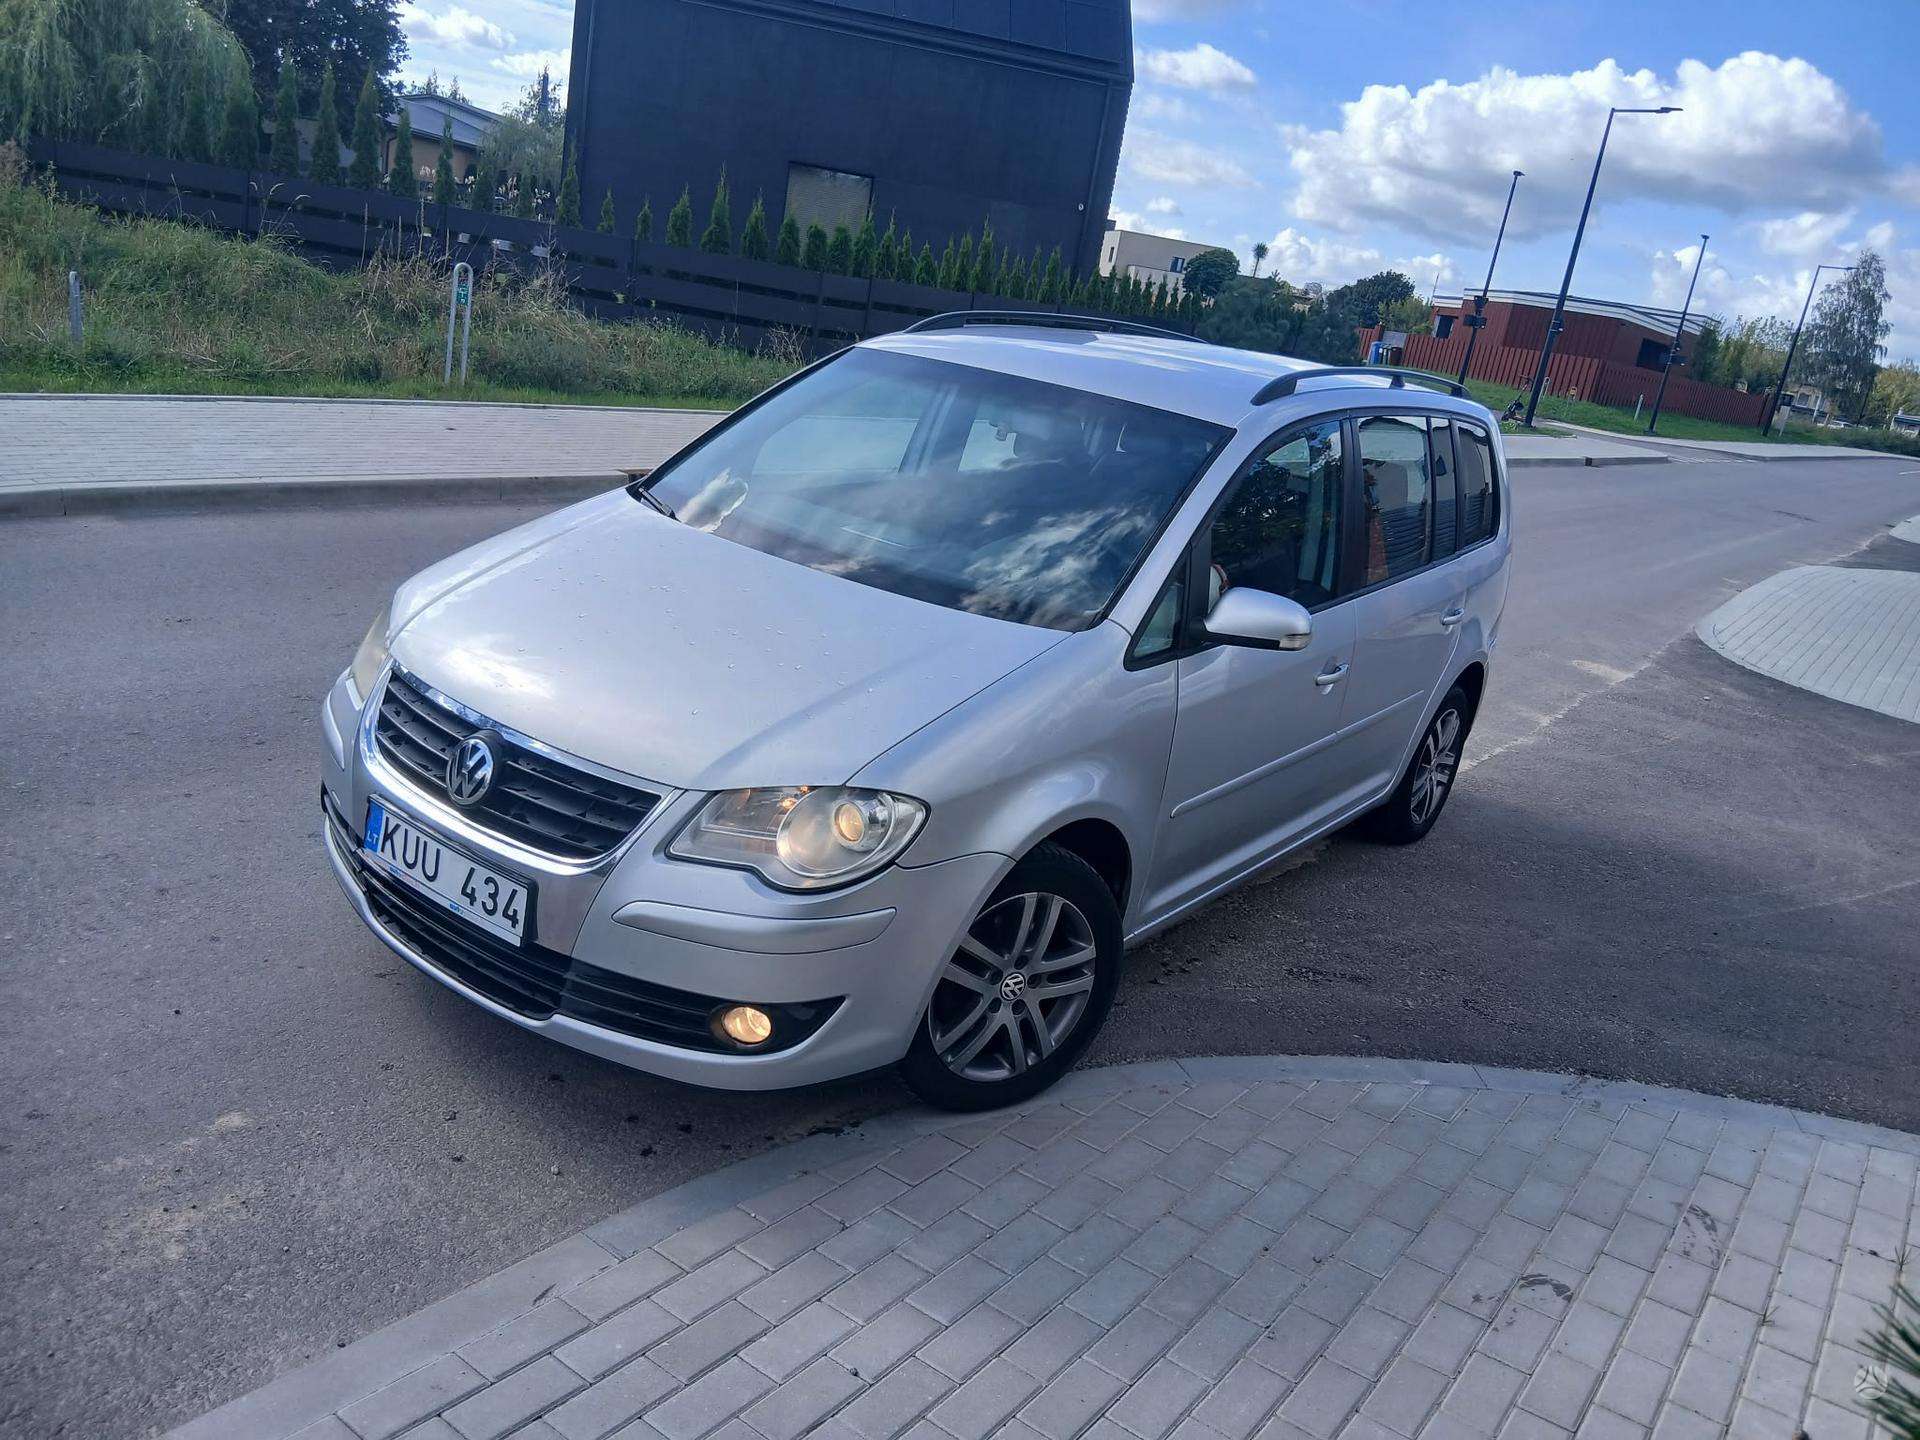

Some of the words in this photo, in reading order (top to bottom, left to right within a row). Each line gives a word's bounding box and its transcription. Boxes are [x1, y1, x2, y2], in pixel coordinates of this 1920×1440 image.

[446, 738, 494, 805] VW
[366, 829, 379, 846] LT
[380, 815, 442, 882] KUU
[460, 866, 519, 929] 434
